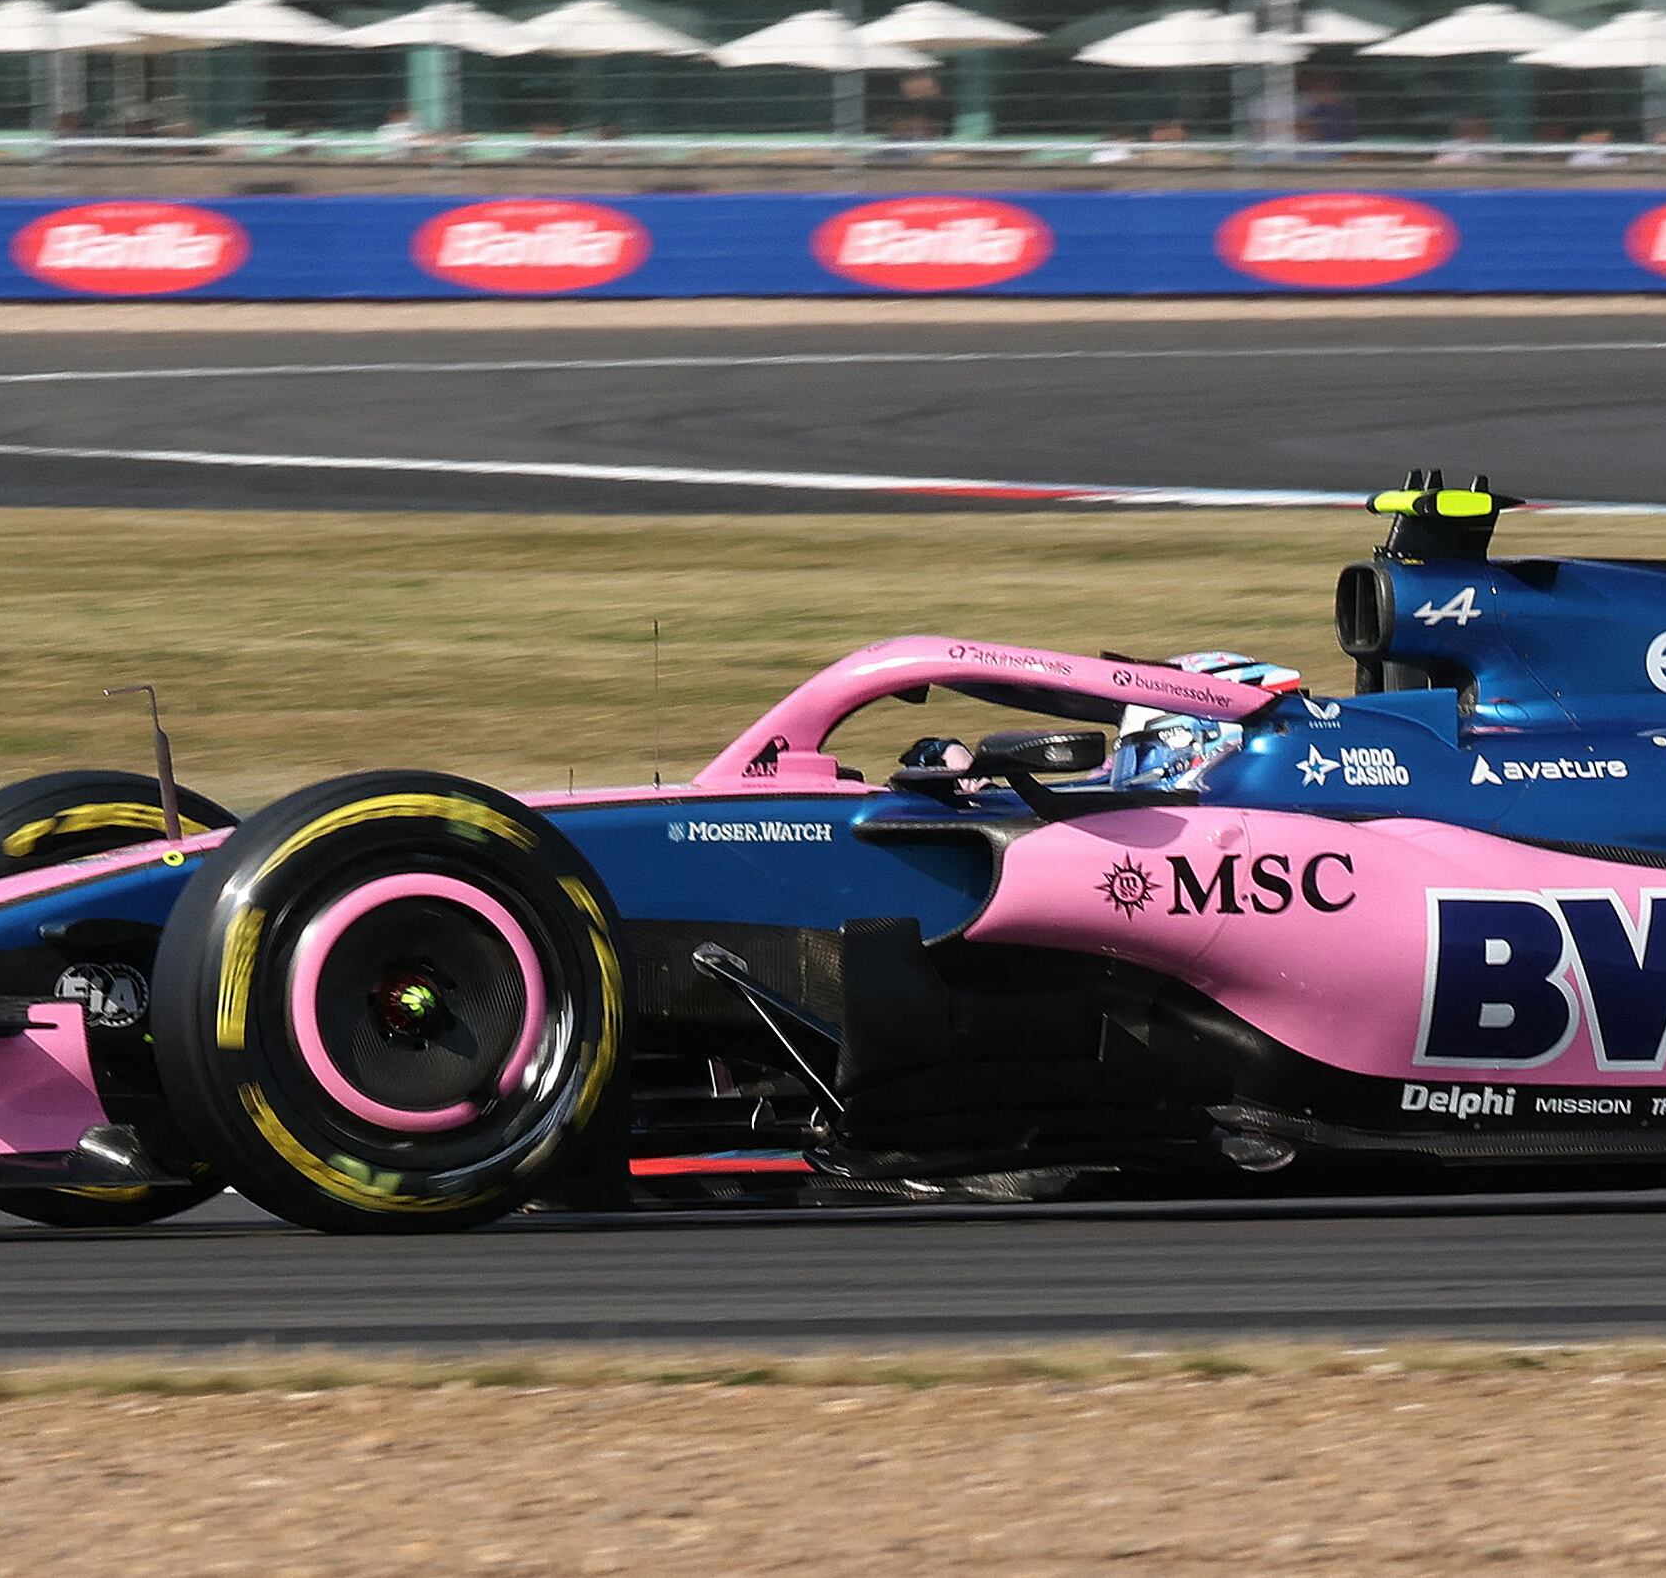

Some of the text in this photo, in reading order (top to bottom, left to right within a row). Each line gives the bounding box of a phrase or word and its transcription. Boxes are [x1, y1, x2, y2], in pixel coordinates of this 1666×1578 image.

[1135, 674, 1232, 709] businessolver
[1340, 747, 1396, 767] MODO
[1343, 765, 1411, 786] CASINO
[1503, 758, 1629, 781] avature
[1165, 852, 1356, 915] MSC
[1401, 1083, 1517, 1120] Delphi
[1535, 1097, 1632, 1115] MISSION
